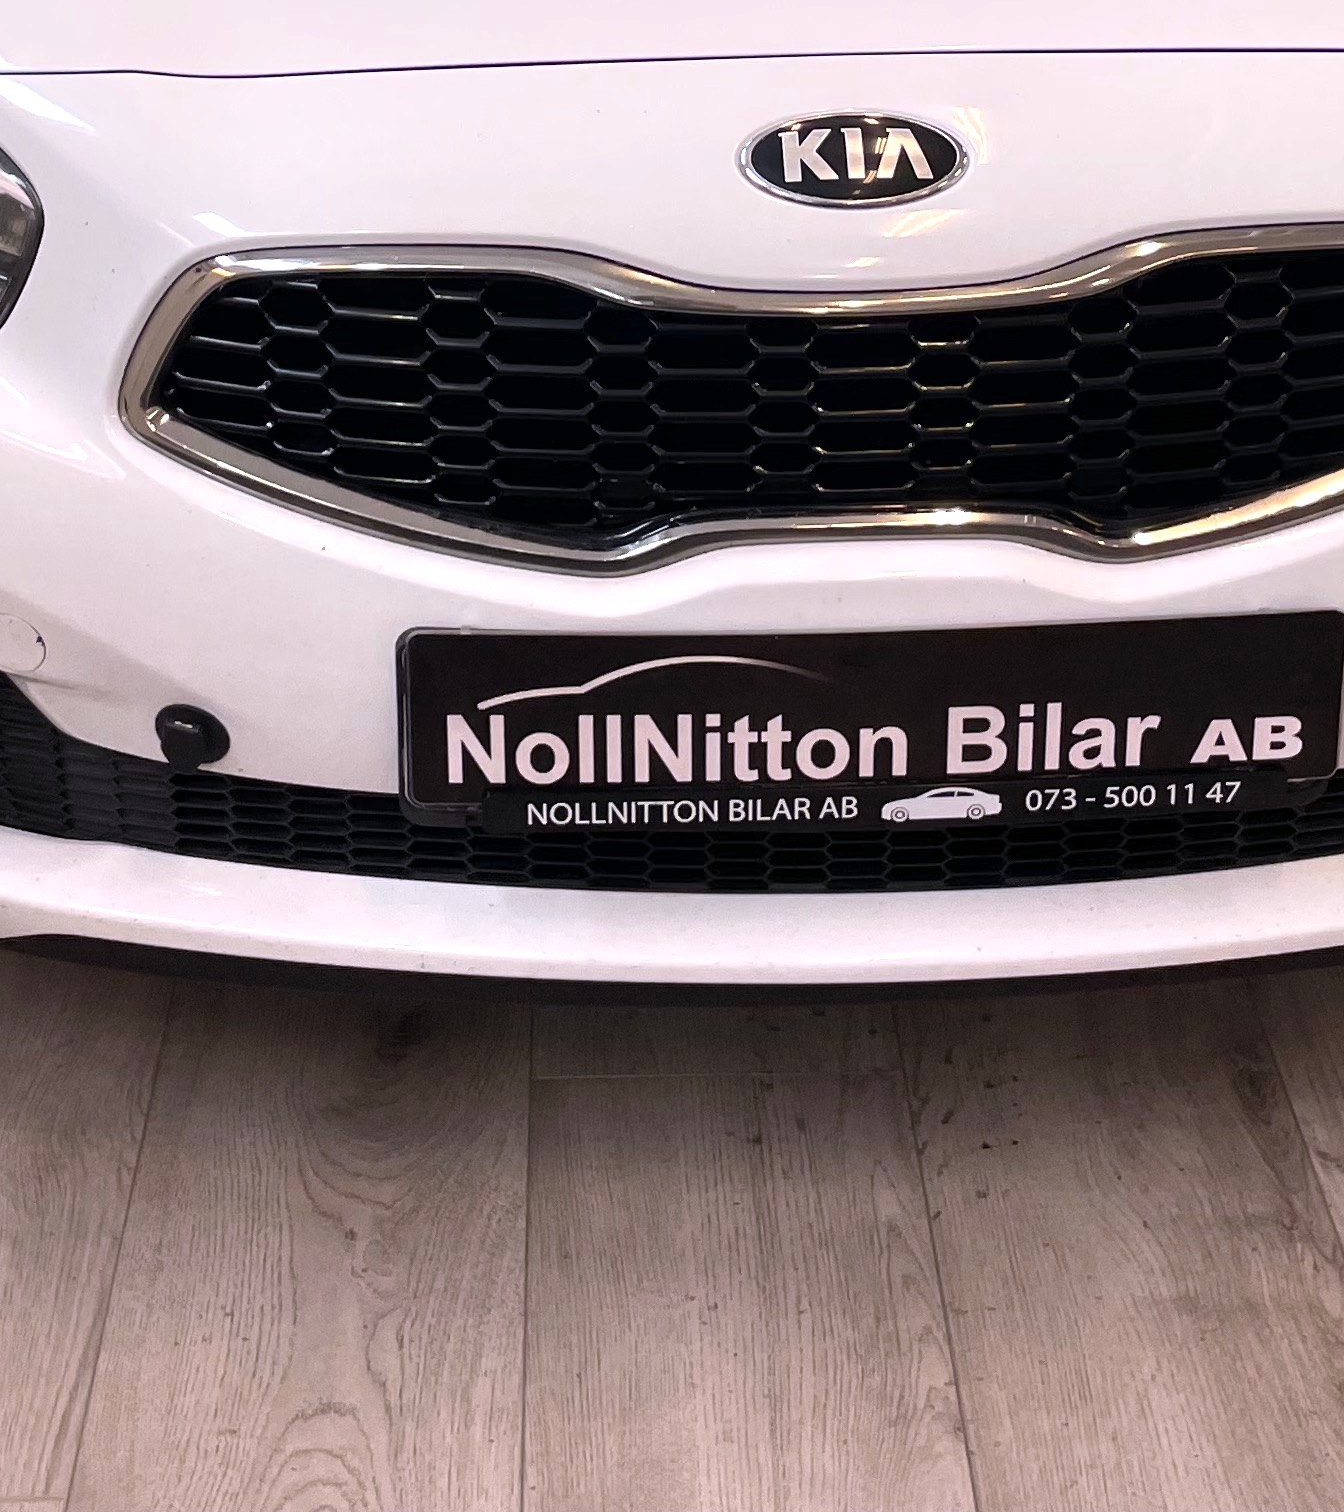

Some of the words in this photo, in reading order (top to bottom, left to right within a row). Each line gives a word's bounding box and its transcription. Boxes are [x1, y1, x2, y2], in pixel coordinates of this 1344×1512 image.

[777, 127, 934, 183] KIA
[446, 713, 908, 785] NollNitton
[946, 701, 1162, 775] Bilar
[1189, 715, 1304, 764] AB
[526, 799, 719, 826] NOLLNITTON
[728, 797, 811, 821] BILAR
[818, 796, 859, 820] AB
[1025, 788, 1077, 812] 073
[1103, 785, 1157, 809] 500
[1166, 784, 1195, 806] 11
[1205, 781, 1243, 805] 47
